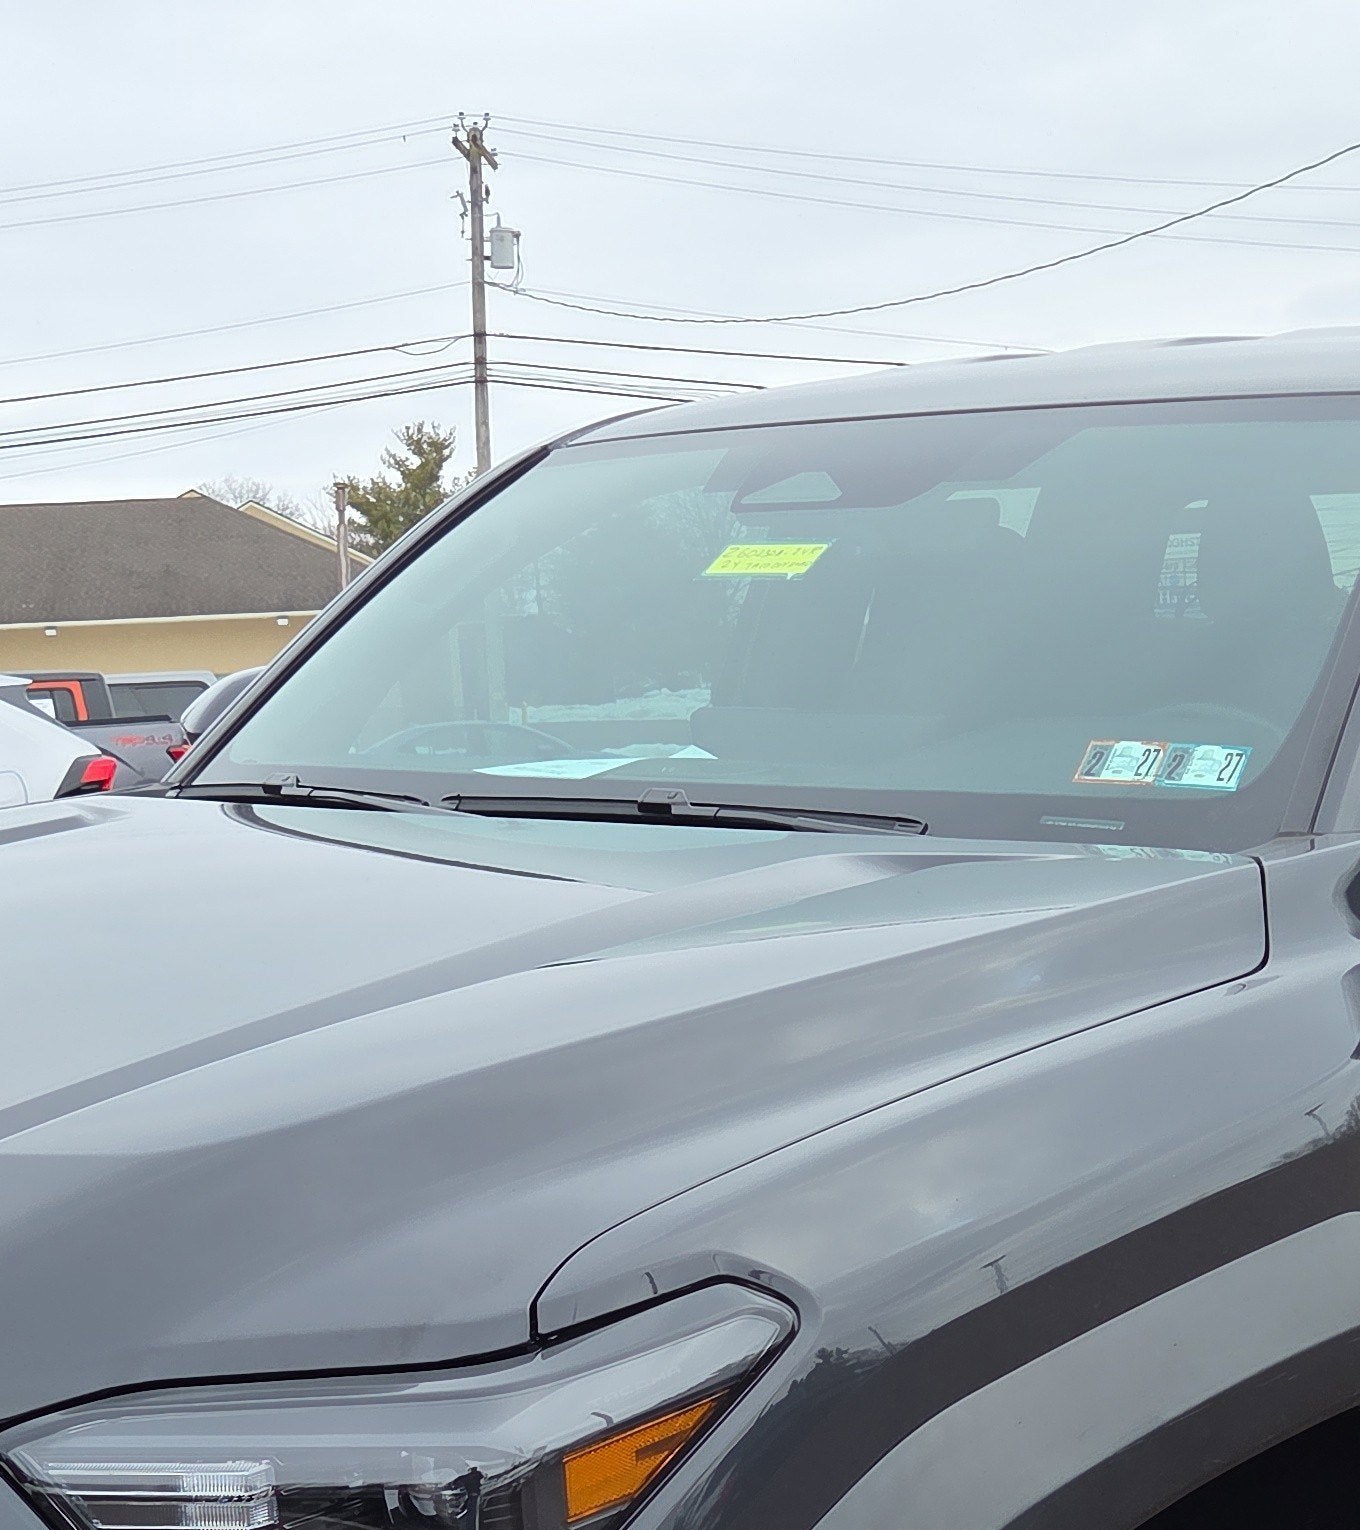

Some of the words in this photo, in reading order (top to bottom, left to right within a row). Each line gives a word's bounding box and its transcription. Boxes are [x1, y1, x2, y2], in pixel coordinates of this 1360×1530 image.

[1083, 750, 1106, 777] 2
[1134, 748, 1162, 777] 27
[1164, 753, 1186, 782] 2
[1216, 752, 1244, 784] 27
